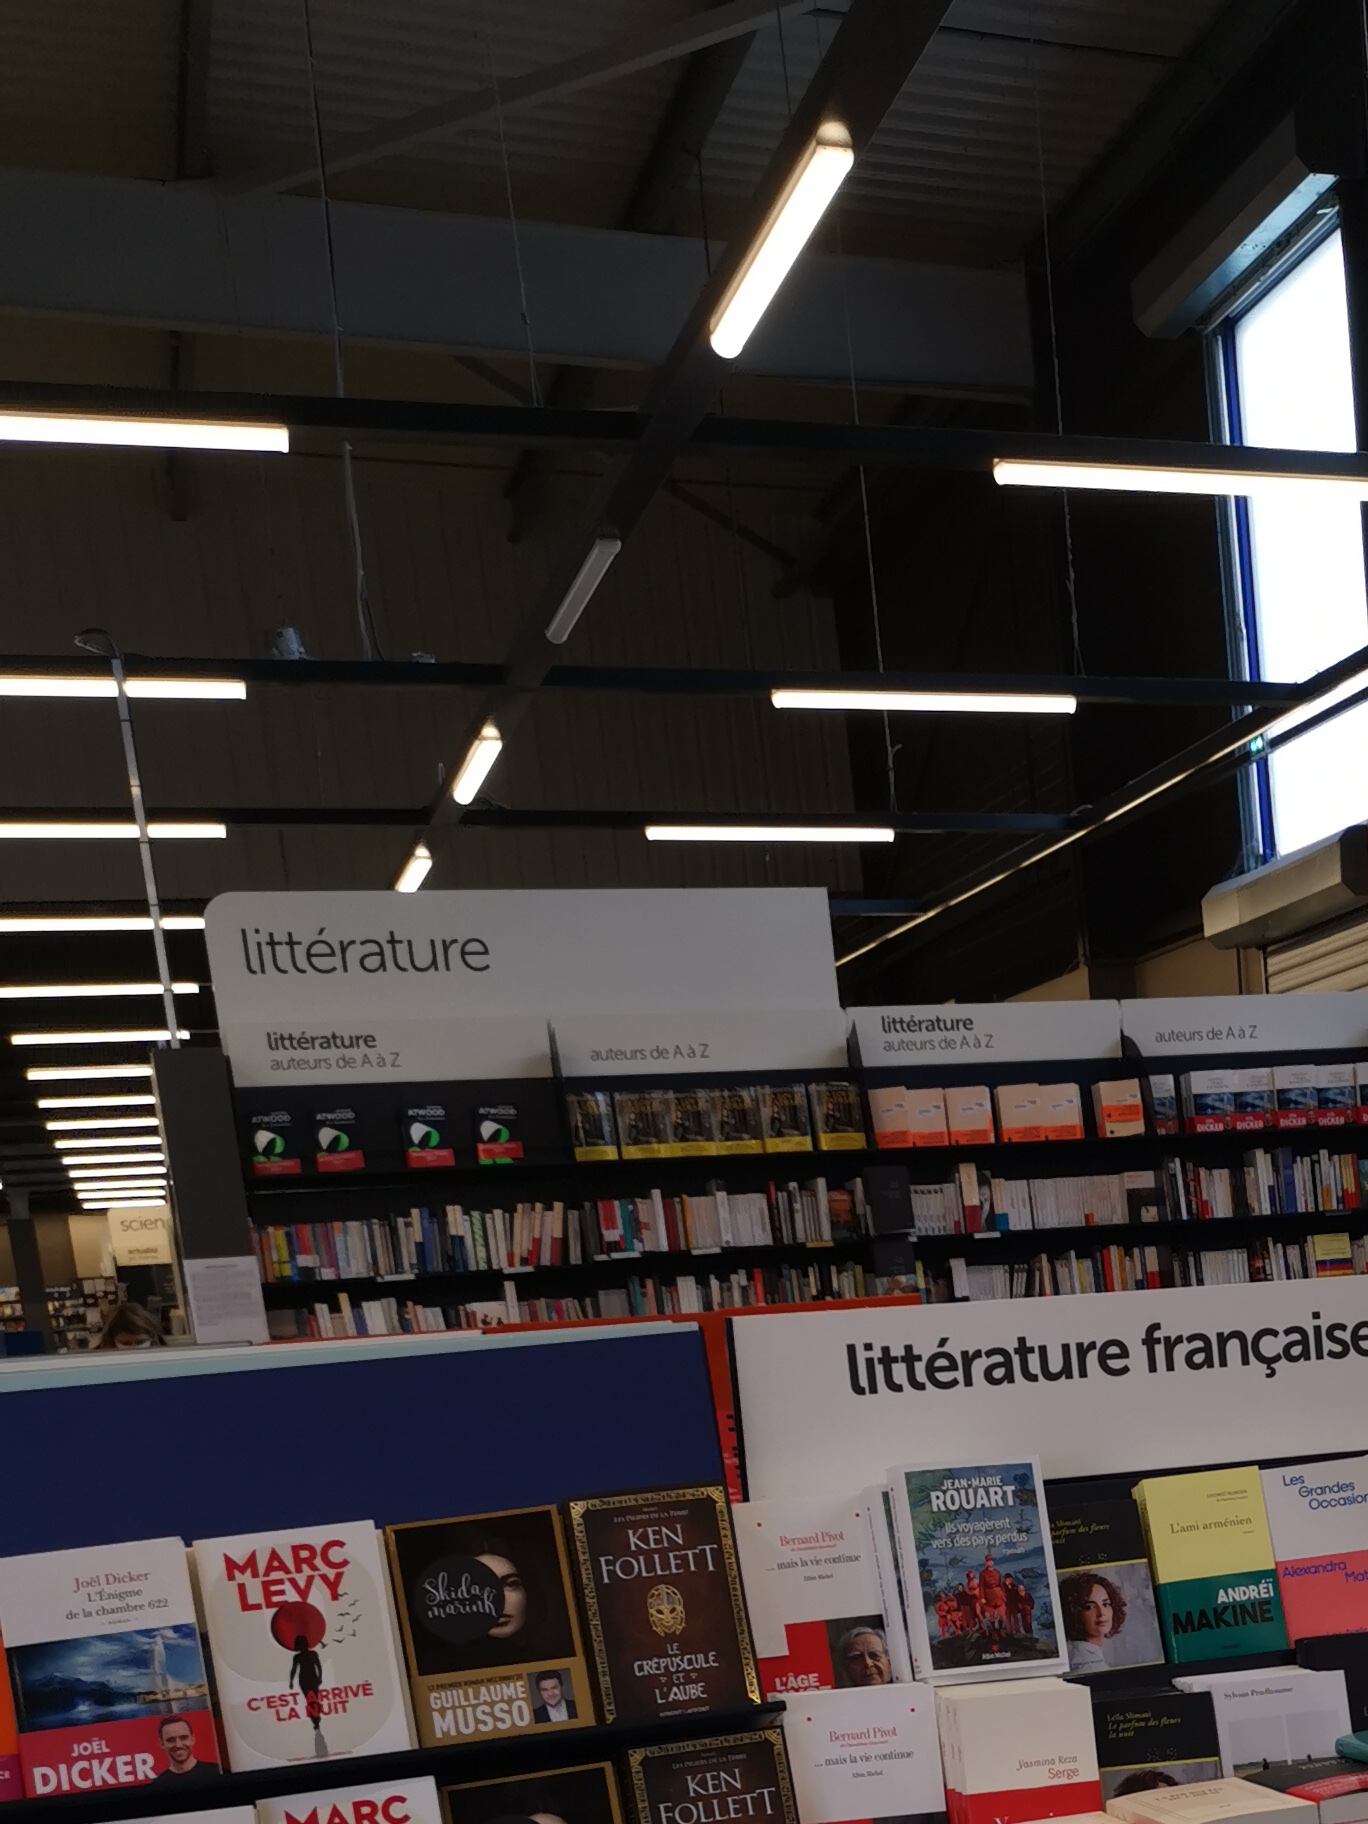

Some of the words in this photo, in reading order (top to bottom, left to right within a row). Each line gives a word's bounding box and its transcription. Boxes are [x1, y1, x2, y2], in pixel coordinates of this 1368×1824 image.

[241, 926, 491, 976] littérature
[881, 1015, 973, 1033] littérature
[1155, 1029, 1203, 1043] auteurs
[1206, 1027, 1223, 1040] de
[1226, 1026, 1236, 1040] A
[1248, 1025, 1258, 1038] Z
[267, 1031, 377, 1051] littérature
[590, 1047, 647, 1061] auteurs
[650, 1045, 670, 1059] de
[673, 1044, 685, 1059] A
[699, 1043, 710, 1058] Z
[883, 1038, 936, 1052] auteurs
[939, 1036, 957, 1050] de
[960, 1035, 970, 1049] A
[985, 1034, 994, 1048] Z
[271, 1056, 332, 1071] auteurs
[336, 1054, 357, 1069] de
[361, 1053, 374, 1068] A
[390, 1052, 401, 1067] Z
[846, 1334, 1130, 1396] littérature
[941, 1475, 1004, 1490] JEAN-MARIE
[1282, 1473, 1305, 1487] Les
[1298, 1481, 1355, 1497] Grandes
[930, 1484, 1016, 1512] ROUART
[627, 1524, 684, 1551] KEN
[223, 1539, 350, 1582] MARC
[599, 1542, 718, 1584] FOLLETT
[237, 1571, 345, 1612] LEVY
[1217, 1575, 1274, 1604] ANDRÉÏ
[1173, 1600, 1275, 1635] MAKINE
[247, 1693, 299, 1712] C'EST
[305, 1680, 373, 1703] ARRIVÉ
[429, 1681, 527, 1710] GUILLAUME
[275, 1703, 301, 1721] LA
[305, 1700, 348, 1718] NUIT
[432, 1705, 530, 1738] MUSSO
[71, 1736, 110, 1757] JOËL
[829, 1728, 871, 1743] Bernard
[873, 1726, 898, 1738] Pivot
[1052, 1754, 1078, 1765] Reza
[33, 1751, 157, 1795] DICKER
[685, 1768, 742, 1797] KEN
[1047, 1765, 1080, 1781] Serge
